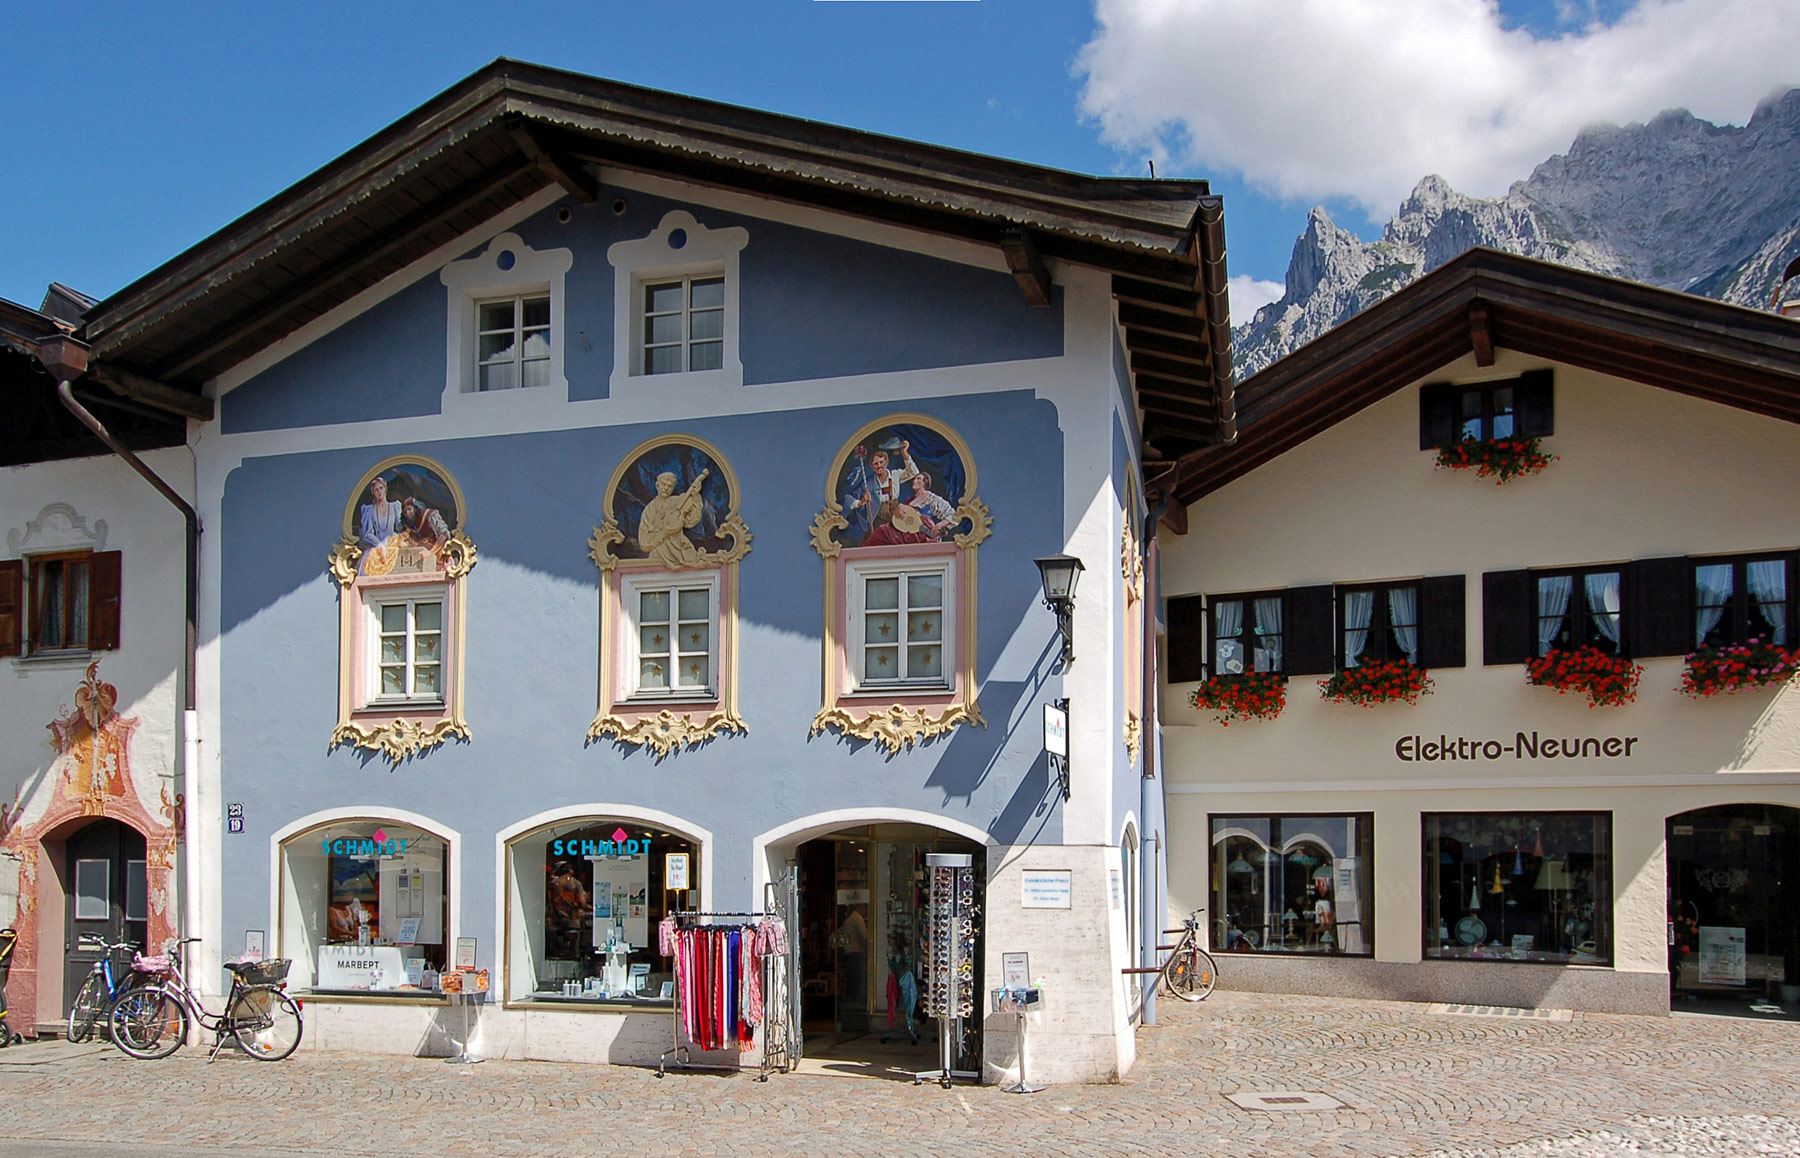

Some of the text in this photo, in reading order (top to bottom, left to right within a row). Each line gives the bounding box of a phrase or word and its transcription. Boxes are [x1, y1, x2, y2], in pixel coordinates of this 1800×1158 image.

[1395, 731, 1638, 762] Elektro-Neuner
[229, 804, 242, 816] 23
[230, 819, 241, 831] 19
[321, 839, 408, 855] SCHMIDT
[553, 839, 652, 856] SCHMIDT
